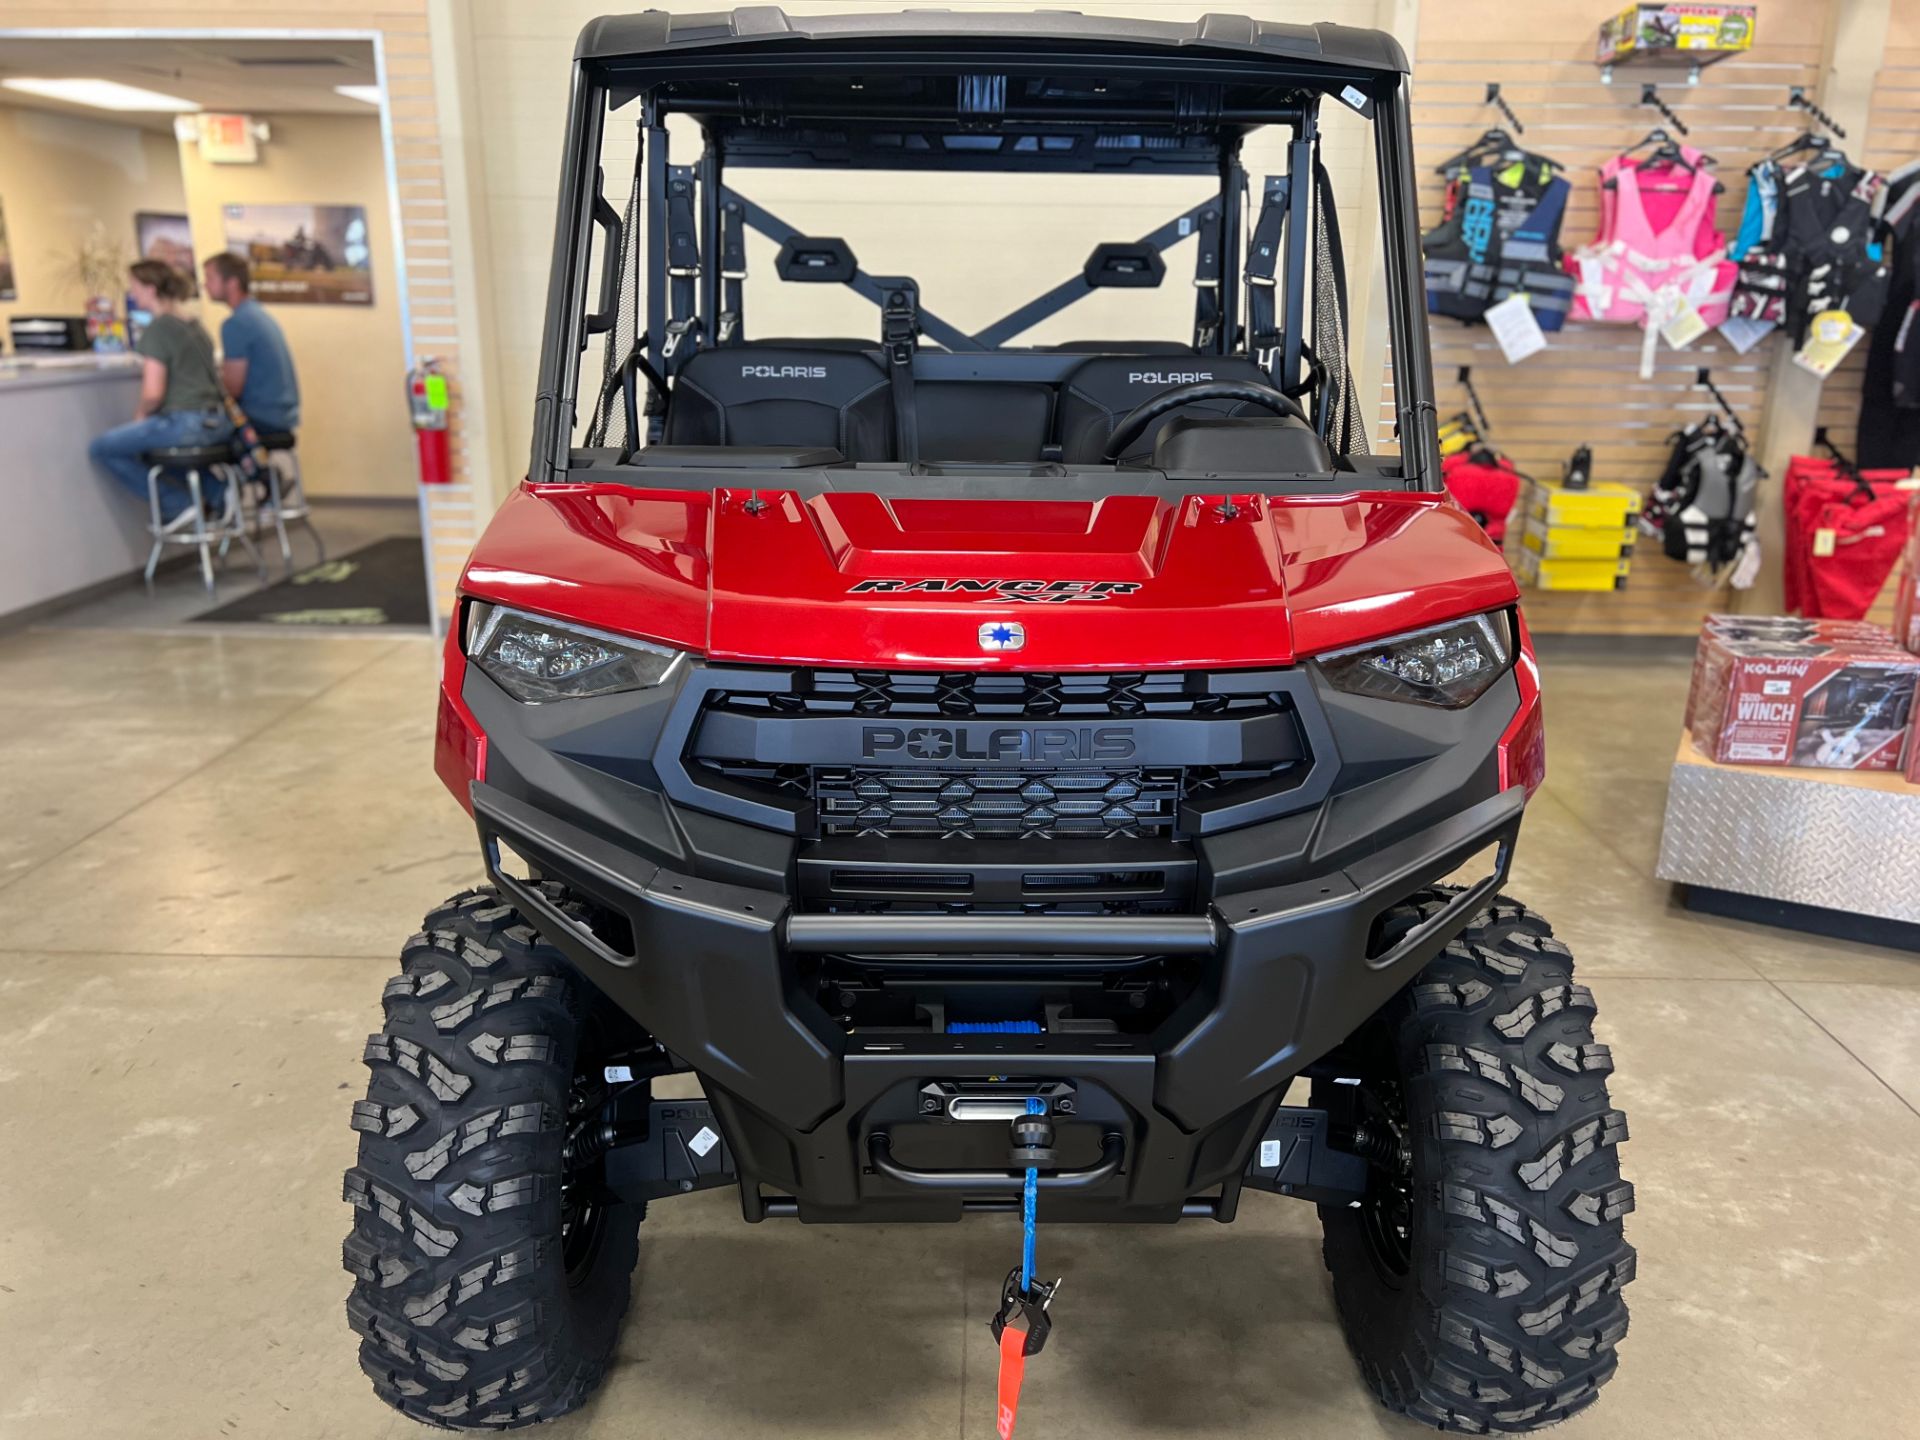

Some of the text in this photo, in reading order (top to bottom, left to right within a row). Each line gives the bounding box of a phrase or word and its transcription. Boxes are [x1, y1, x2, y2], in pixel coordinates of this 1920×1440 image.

[742, 365, 826, 378] POLARIS
[1129, 372, 1213, 384] POLARIS
[846, 579, 1142, 594] RANGER
[976, 592, 1111, 603] XP
[1743, 663, 1808, 677] KOLPIN
[1738, 702, 1796, 721] WINCH
[862, 726, 1136, 761] POLARIS
